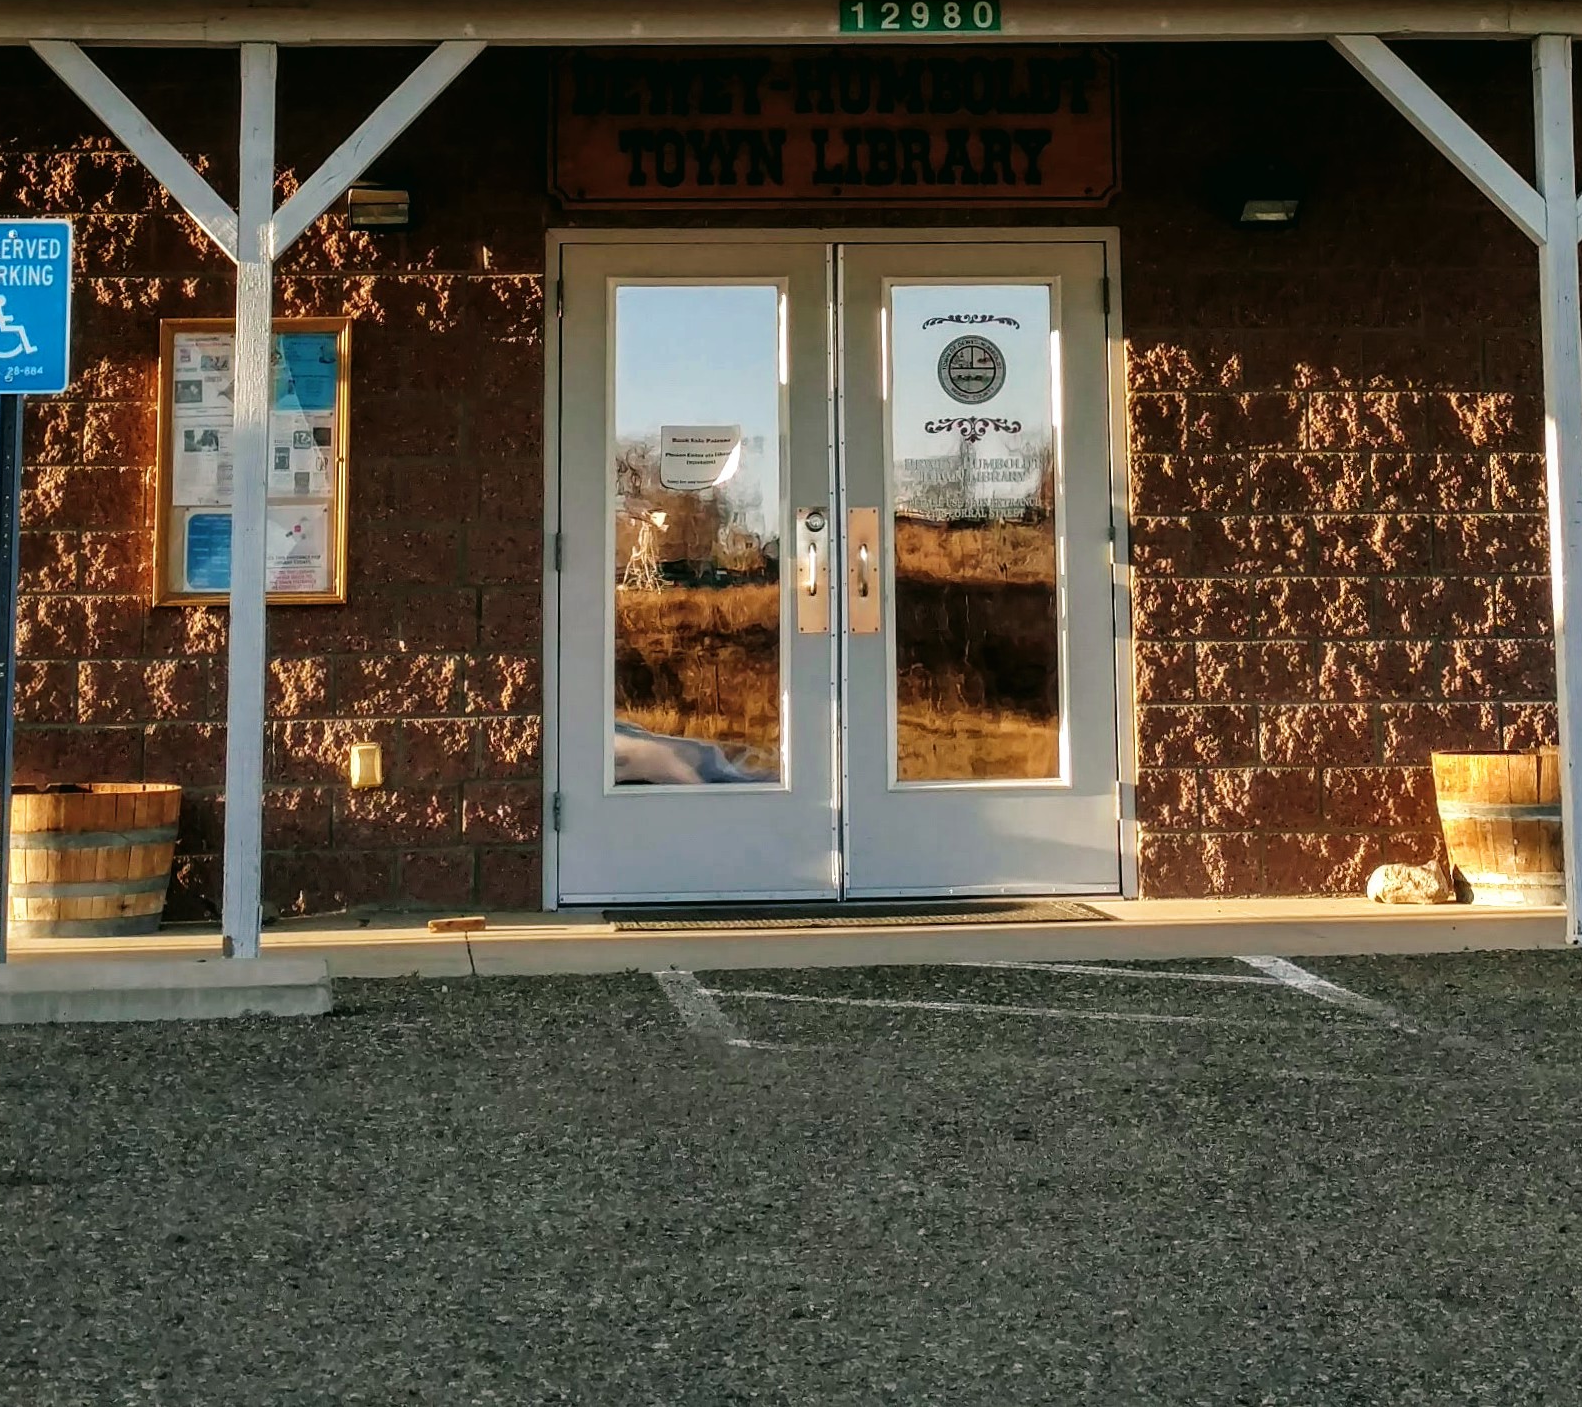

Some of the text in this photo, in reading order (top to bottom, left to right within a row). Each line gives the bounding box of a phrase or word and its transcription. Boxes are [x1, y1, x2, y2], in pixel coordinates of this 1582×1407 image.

[850, 1, 994, 30] 12980
[571, 55, 1098, 115] DEWEY-HUMBOLDT
[619, 128, 1053, 187] TOWN LIBRARY
[989, 508, 1026, 519] STREET
